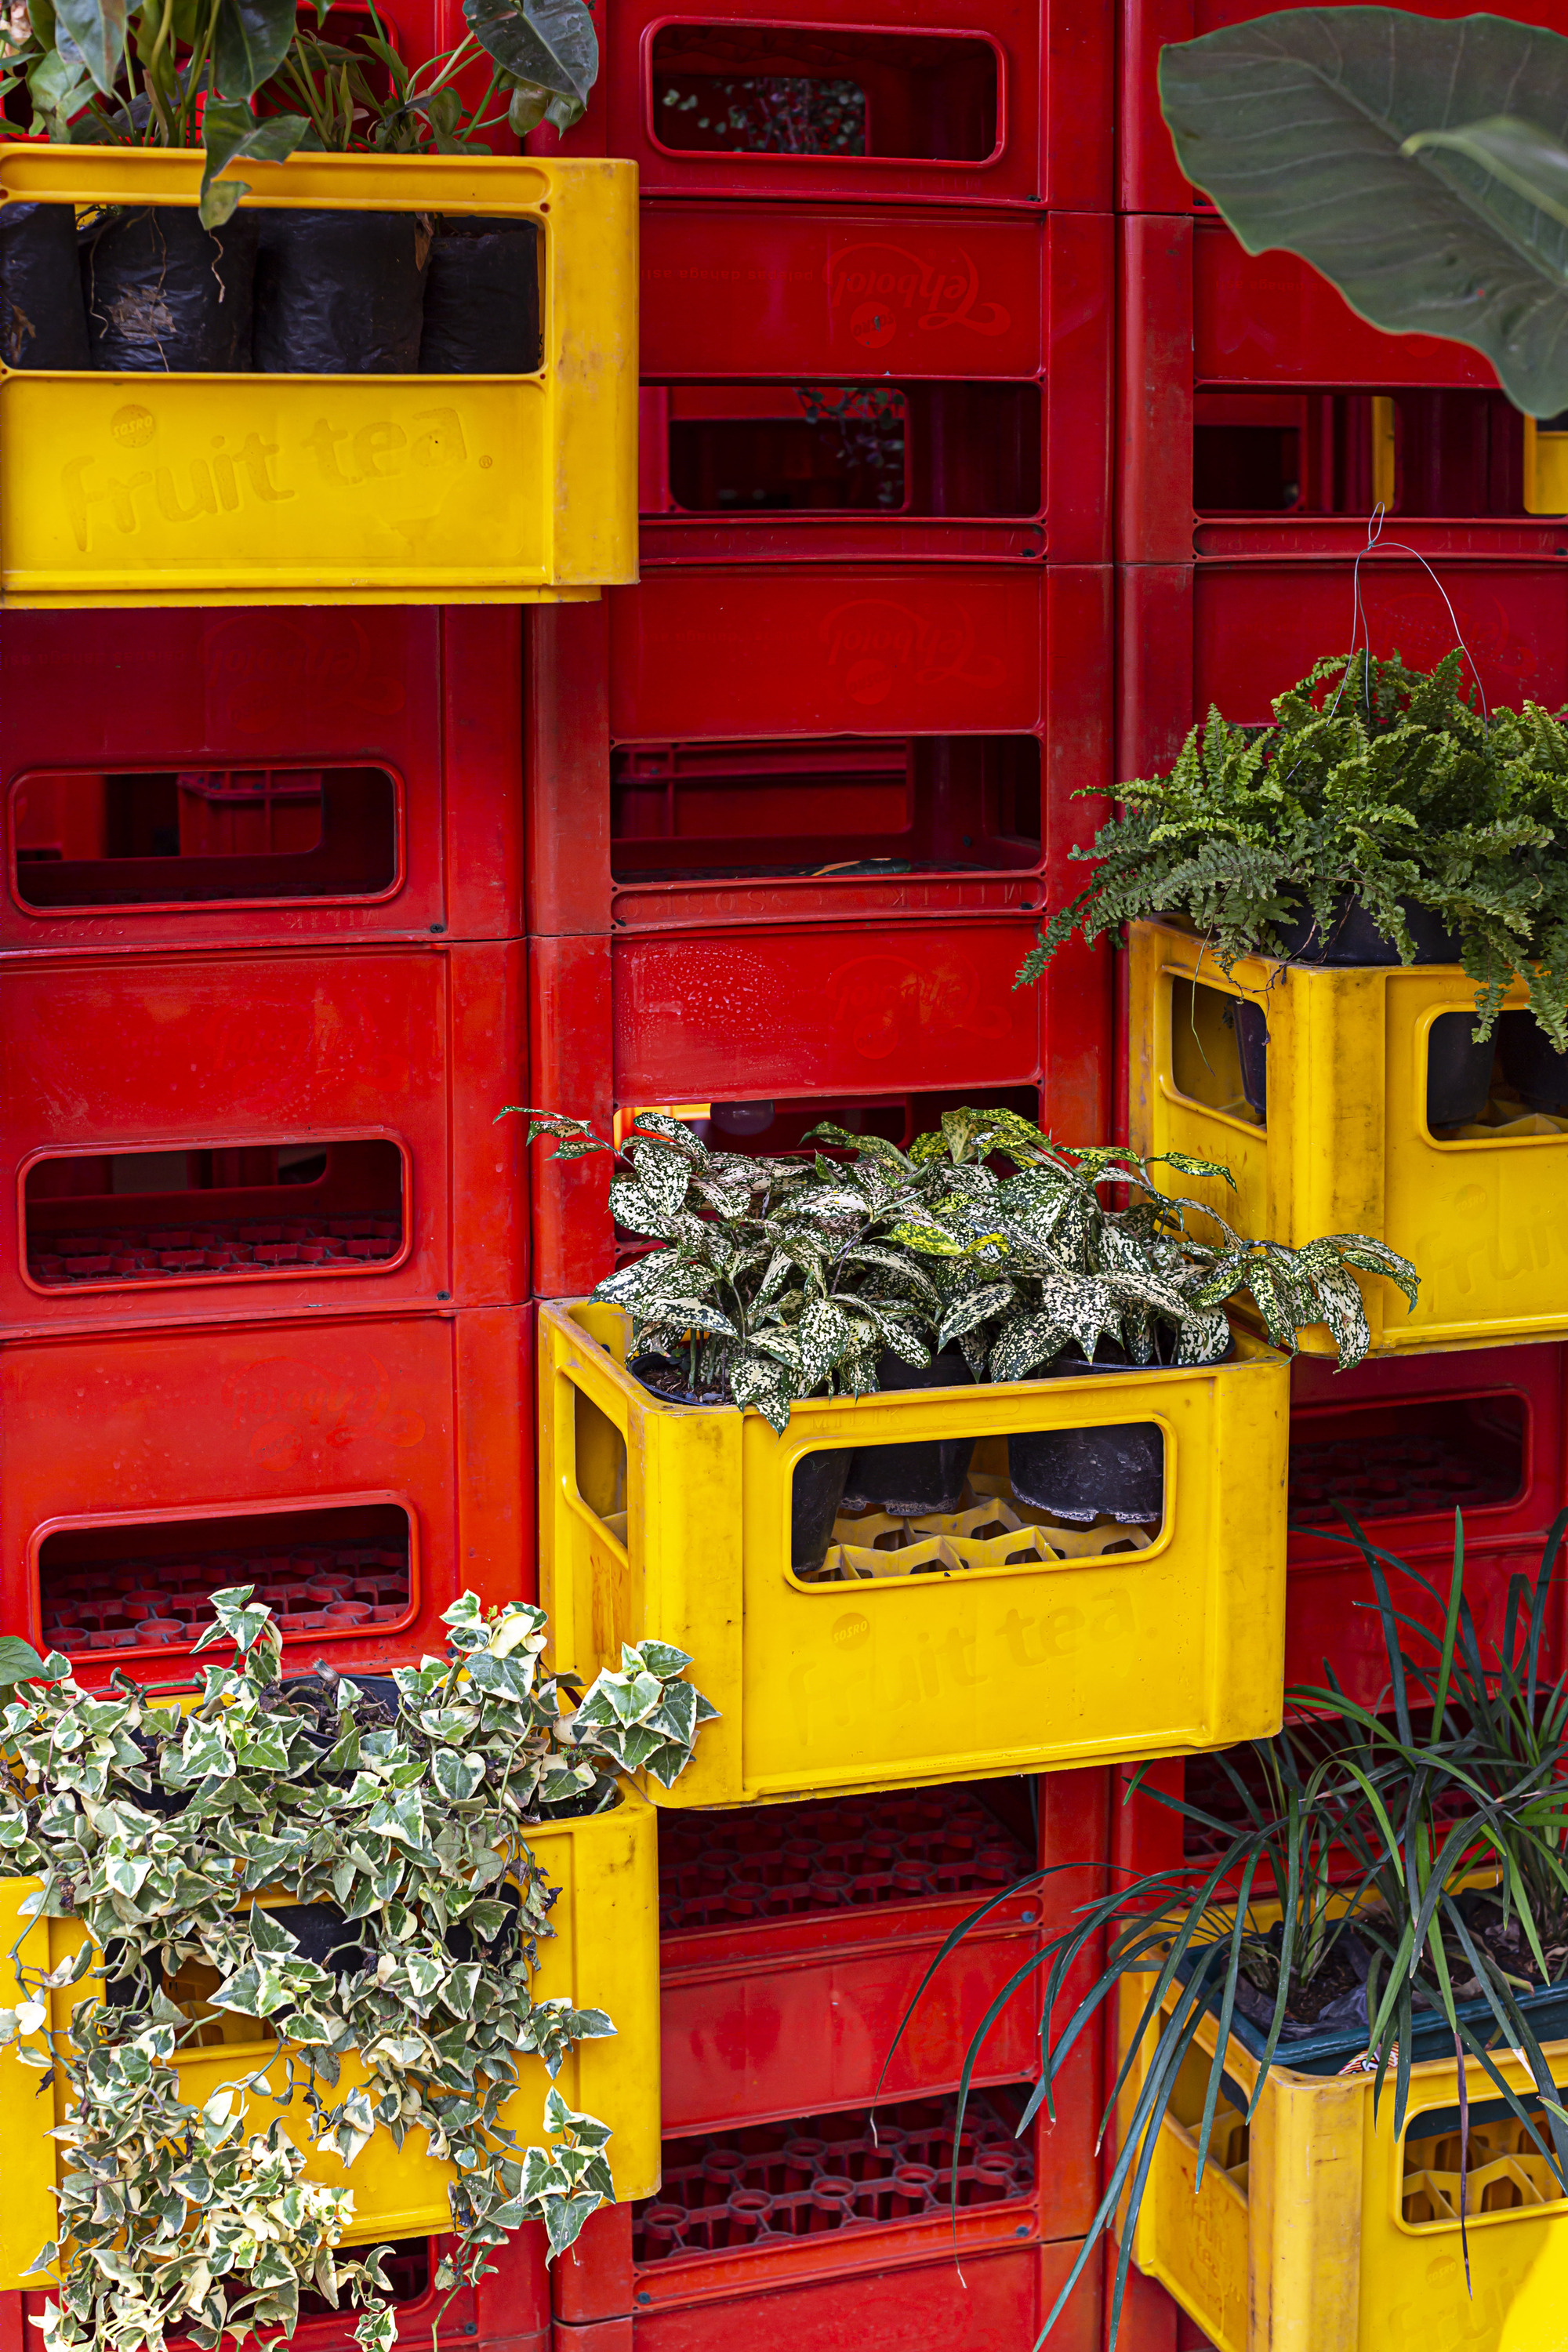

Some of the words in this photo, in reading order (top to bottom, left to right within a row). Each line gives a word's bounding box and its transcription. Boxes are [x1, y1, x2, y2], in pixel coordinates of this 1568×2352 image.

[112, 415, 154, 441] SOSRO
[60, 432, 296, 553] fruit
[300, 406, 469, 488] tea
[810, 1408, 902, 1429] MILIK
[833, 1619, 869, 1644] SOSRO
[788, 1628, 991, 1746] fruit
[994, 1588, 1139, 1668] tea
